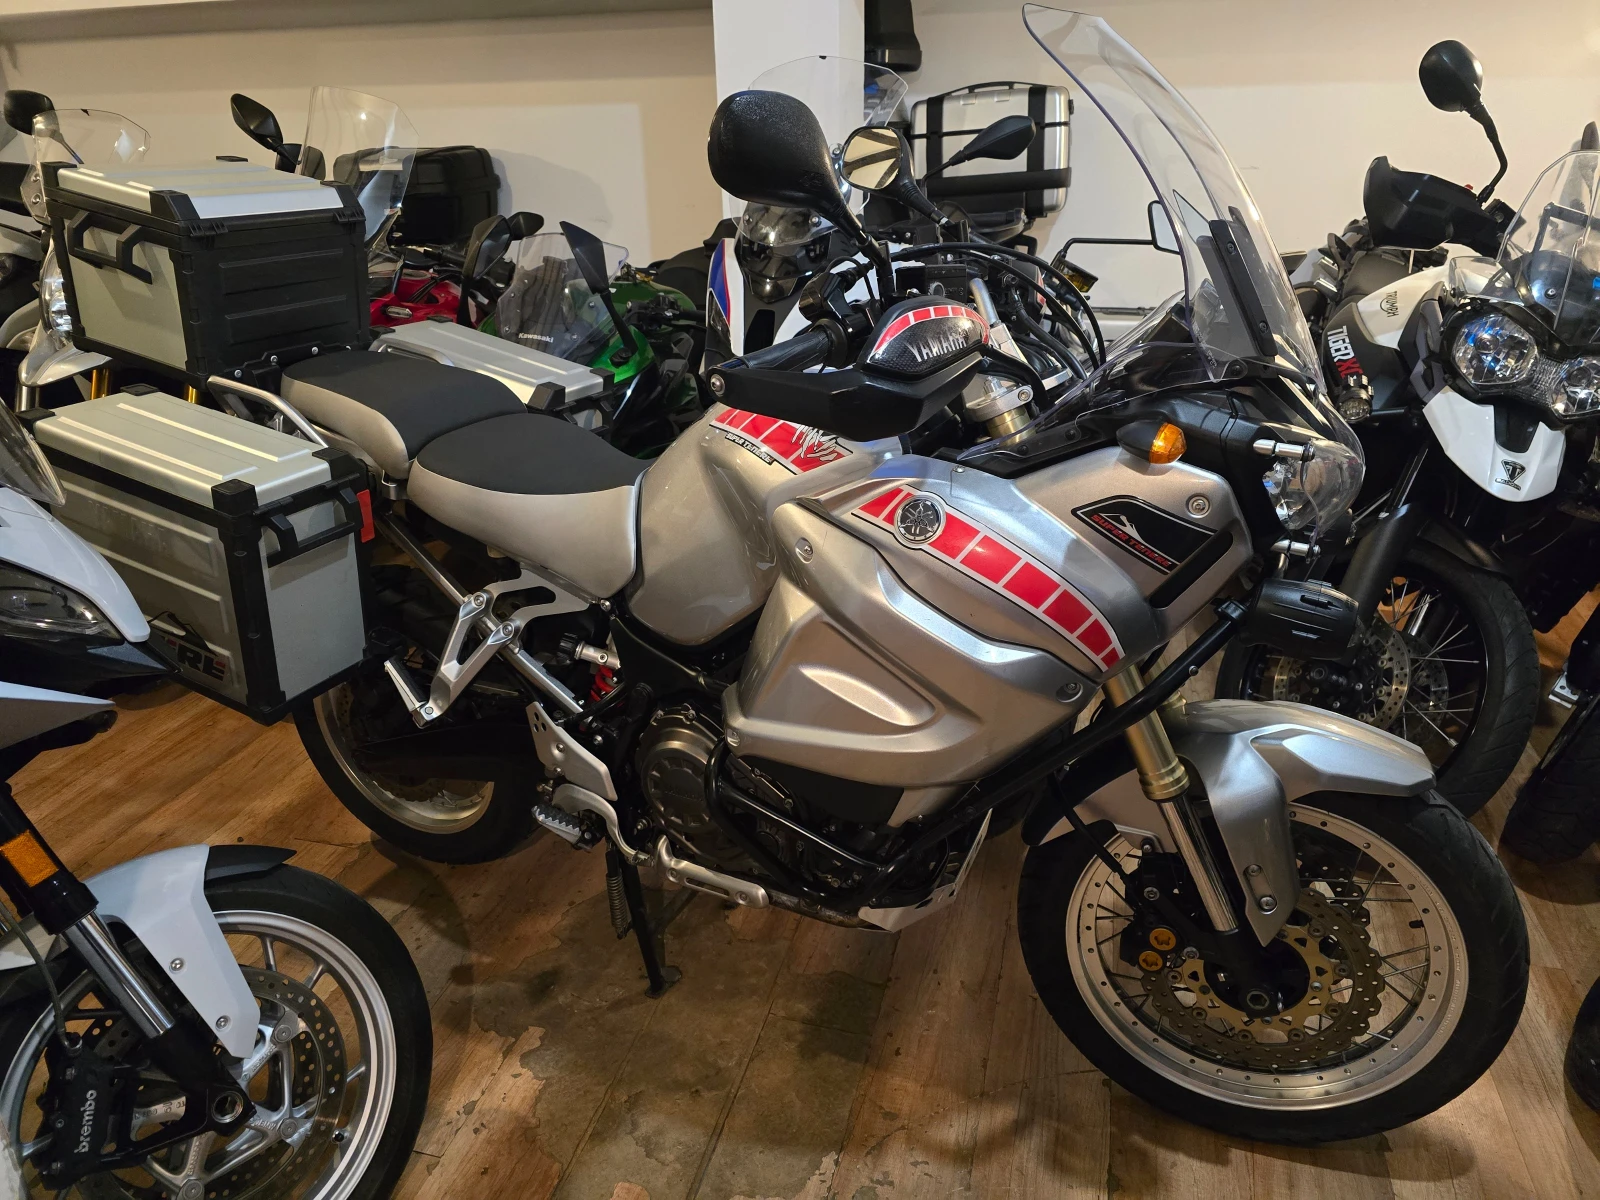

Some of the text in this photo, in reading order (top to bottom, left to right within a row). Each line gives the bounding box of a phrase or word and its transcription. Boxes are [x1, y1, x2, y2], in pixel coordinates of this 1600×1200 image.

[1385, 290, 1399, 318] TRIUMPH
[518, 332, 554, 343] Kawasaki
[903, 333, 967, 363] YAMAHA
[1327, 325, 1355, 363] TIGER
[725, 431, 744, 447] SUPER
[1090, 514, 1130, 541] SUPER
[74, 1089, 97, 1153] brembo
